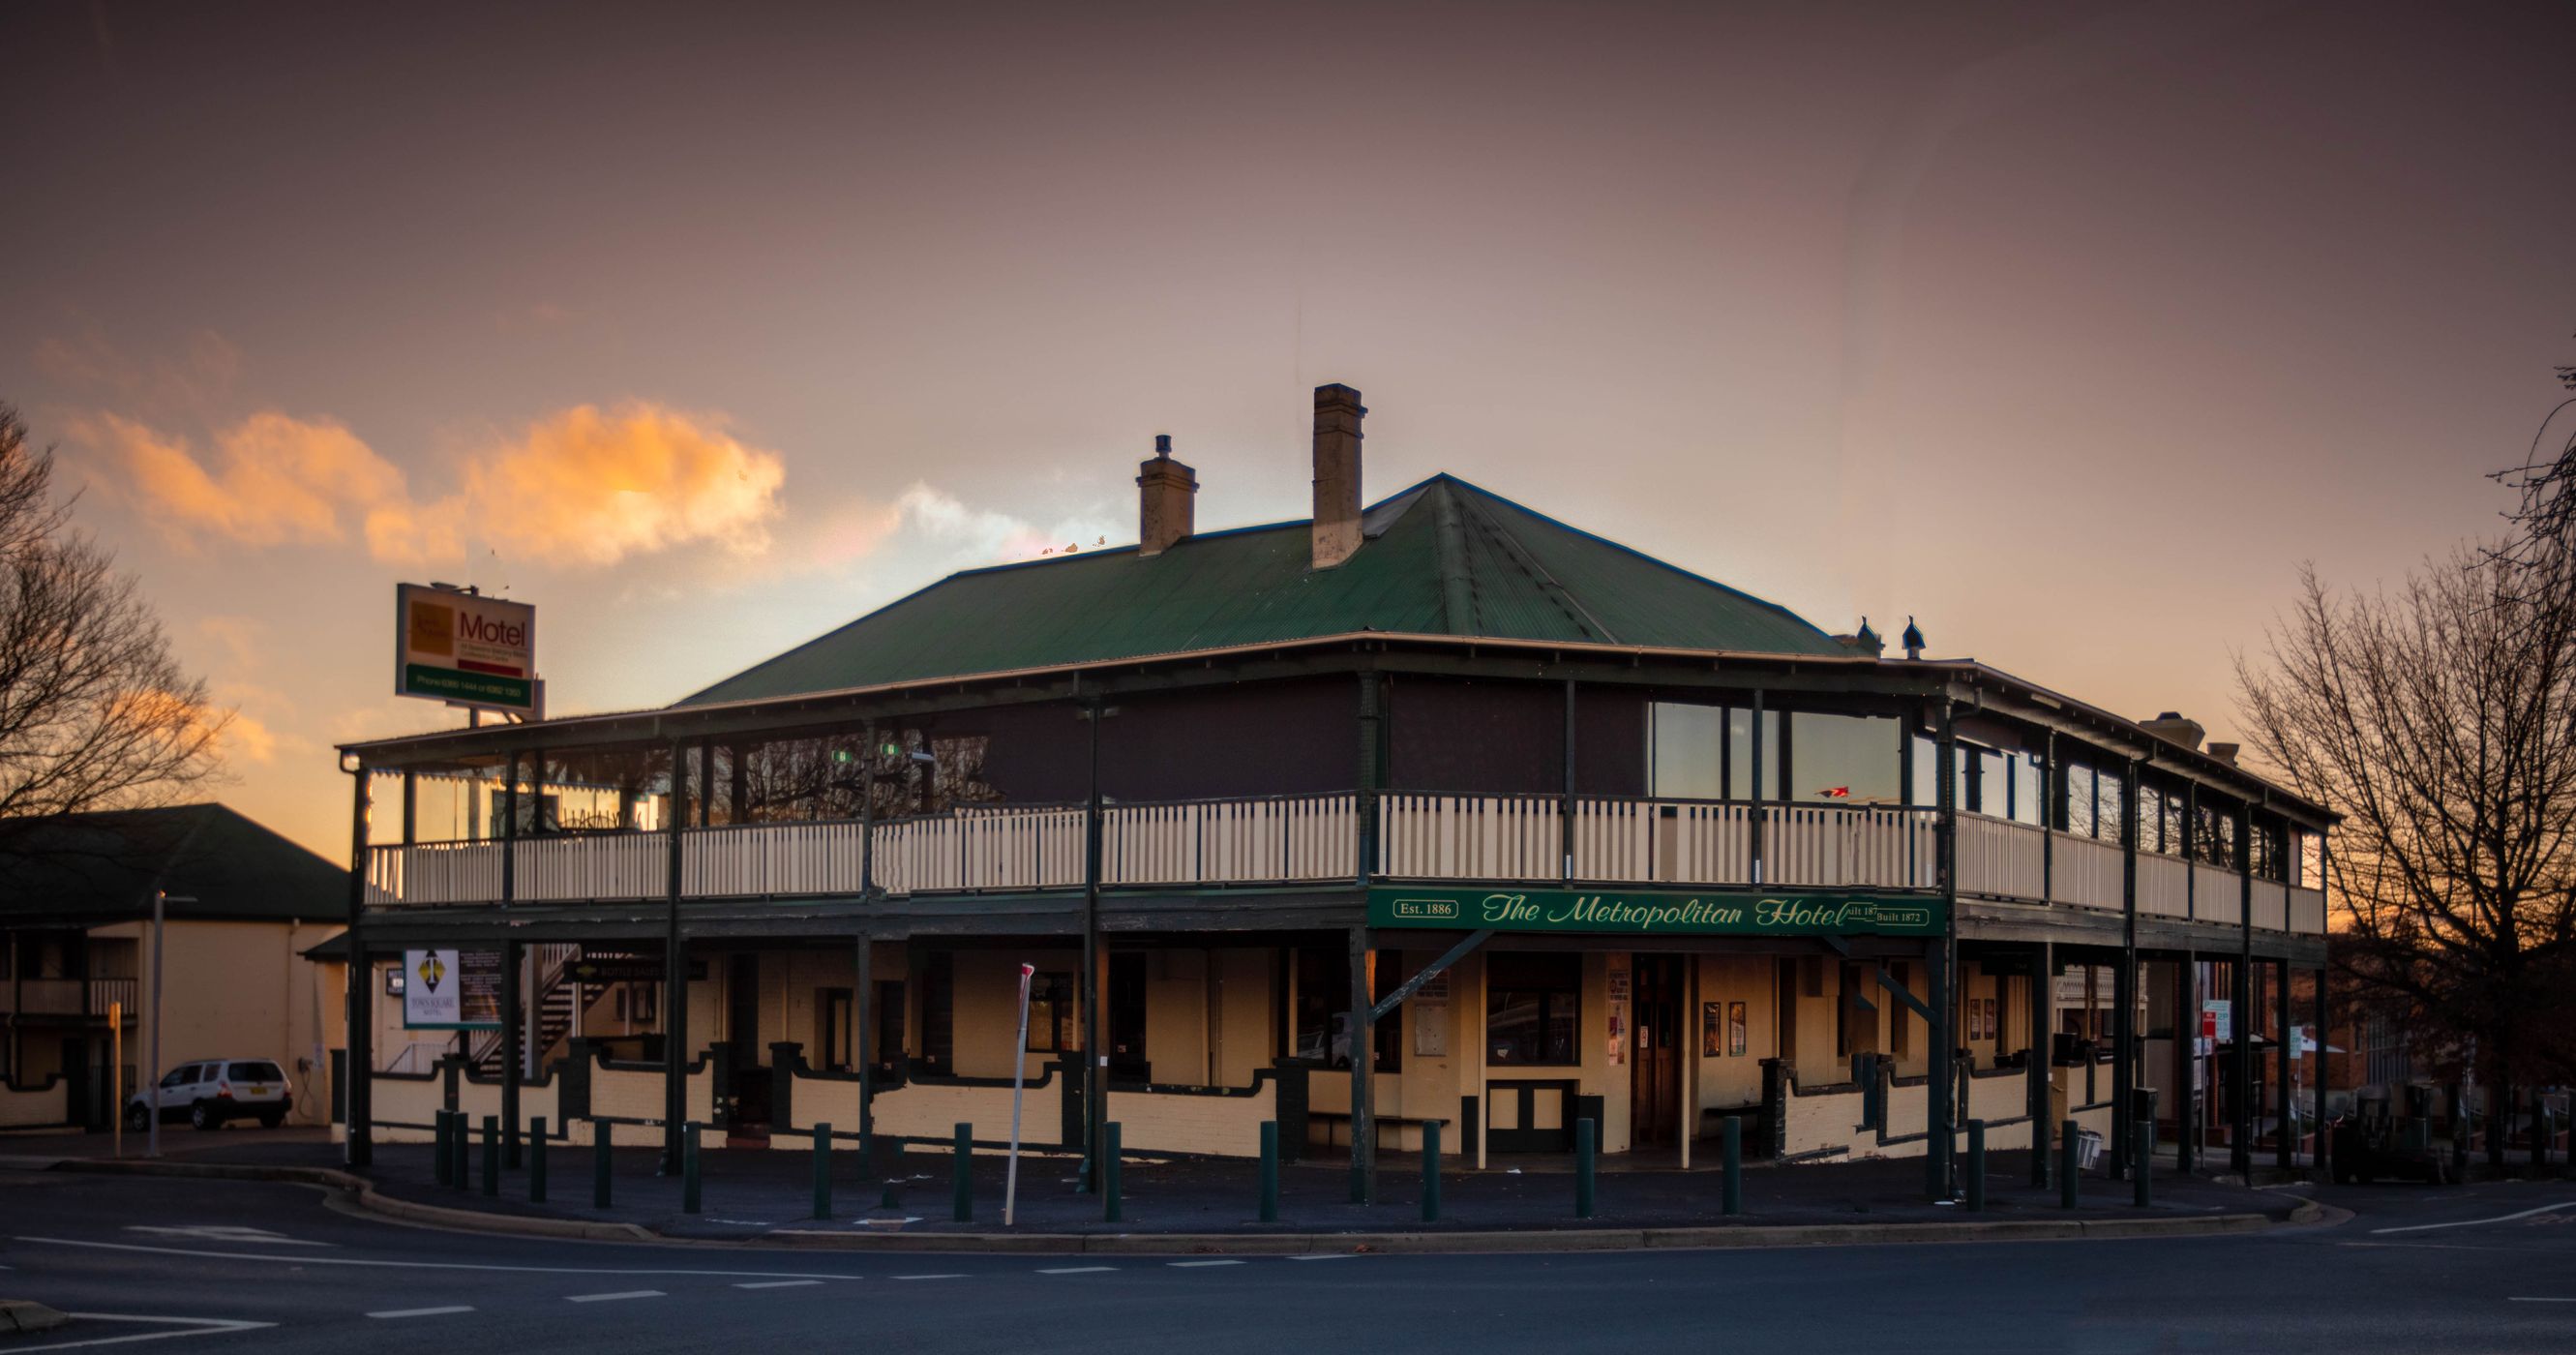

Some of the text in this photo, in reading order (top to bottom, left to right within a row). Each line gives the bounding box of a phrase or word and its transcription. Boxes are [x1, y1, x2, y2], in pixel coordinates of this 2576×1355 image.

[460, 612, 525, 646] Motel
[1400, 903, 1452, 915] Est. 1886
[1483, 894, 1850, 929] The Metropolitan Hotel
[1876, 913, 1921, 922] Built 1872
